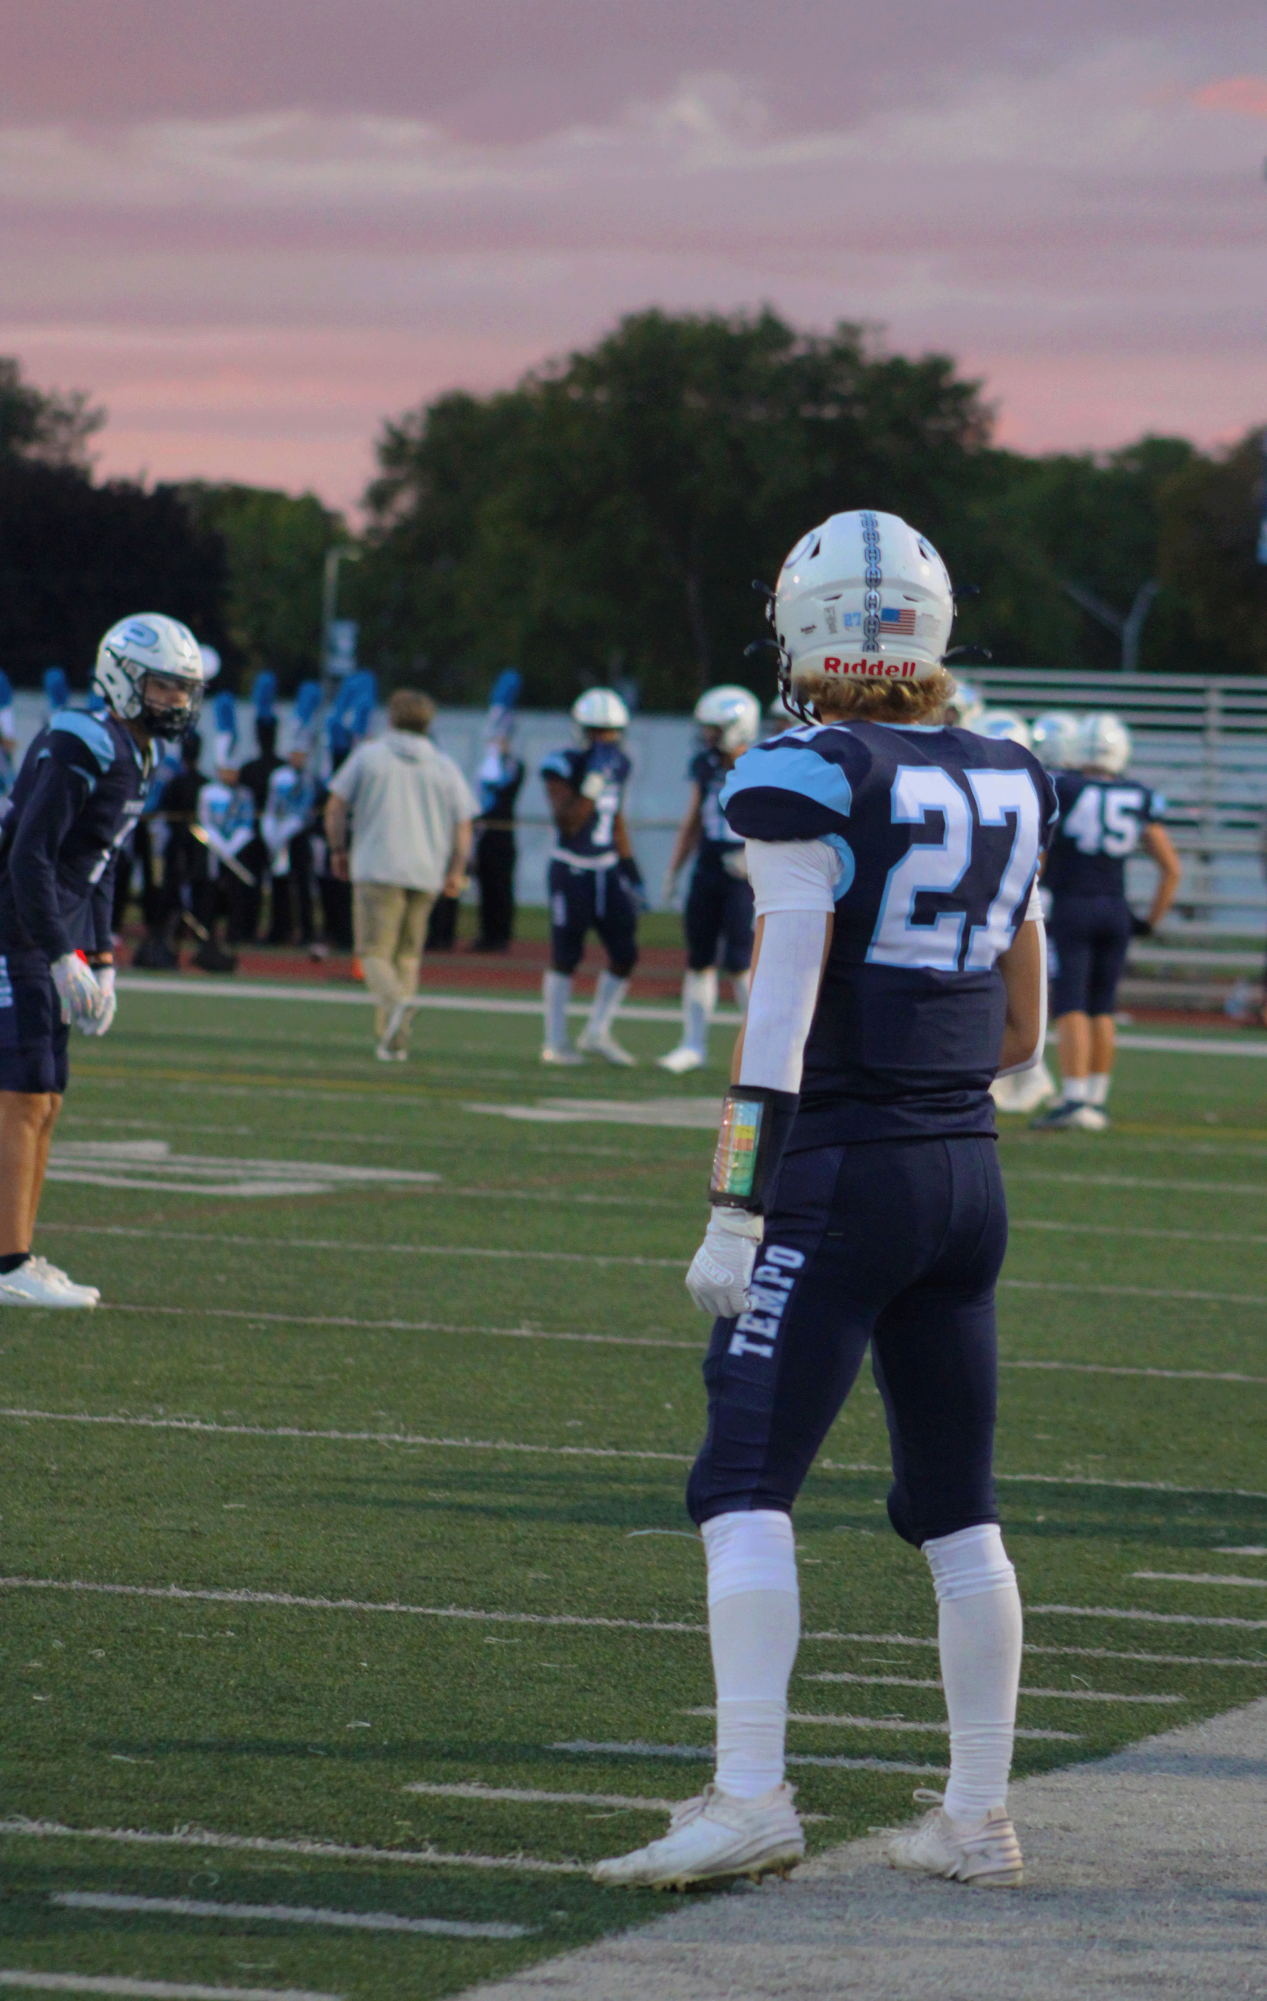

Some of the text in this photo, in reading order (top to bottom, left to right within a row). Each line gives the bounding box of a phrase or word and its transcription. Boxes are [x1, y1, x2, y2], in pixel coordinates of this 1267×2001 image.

[824, 657, 916, 677] Riddell
[864, 764, 1040, 972] 27
[1063, 784, 1144, 858] 45
[728, 1244, 805, 1359] TEMPO
